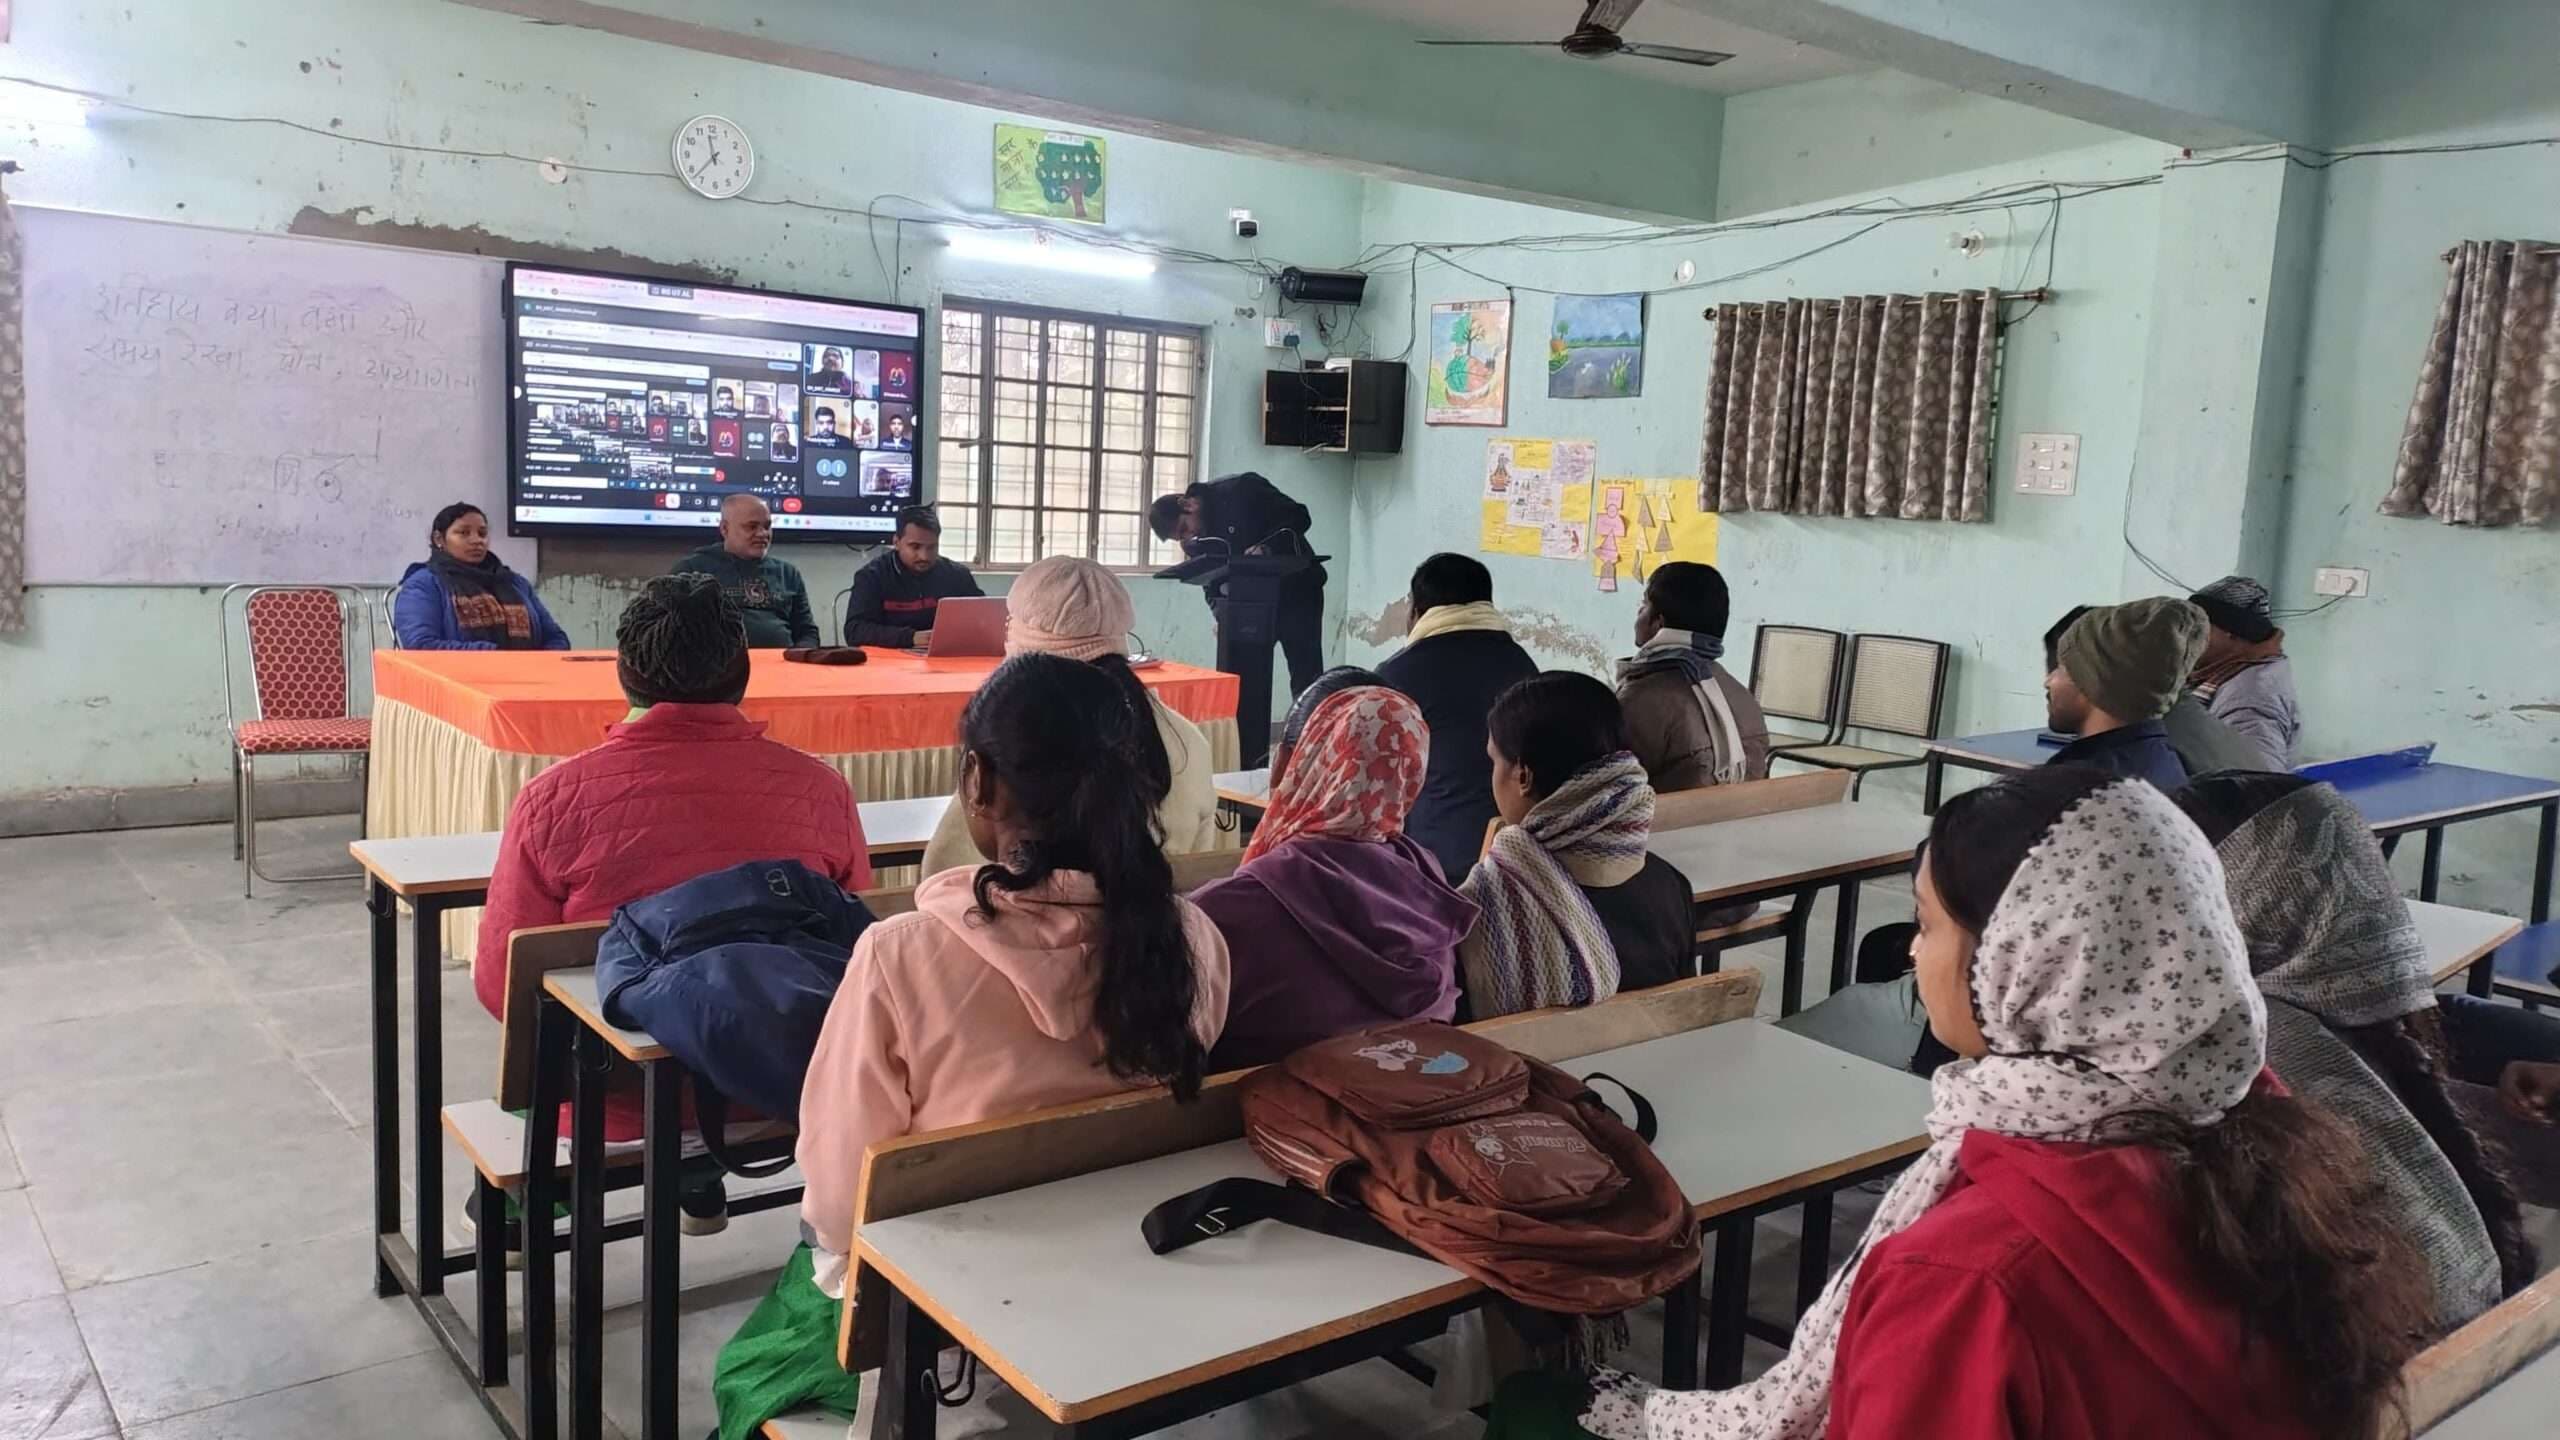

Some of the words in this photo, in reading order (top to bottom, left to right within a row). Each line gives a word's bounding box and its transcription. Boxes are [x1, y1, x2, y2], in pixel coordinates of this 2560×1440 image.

[696, 128, 703, 136] 11
[708, 125, 717, 134] 12
[724, 130, 728, 139] 1
[686, 137, 696, 146] 10
[732, 141, 738, 150] 2
[684, 150, 690, 159] 9
[736, 155, 742, 164] 3
[688, 165, 695, 174] 8
[734, 169, 740, 177] 4
[699, 176, 704, 185] 7
[725, 178, 731, 187] 5
[712, 181, 719, 190] 6
